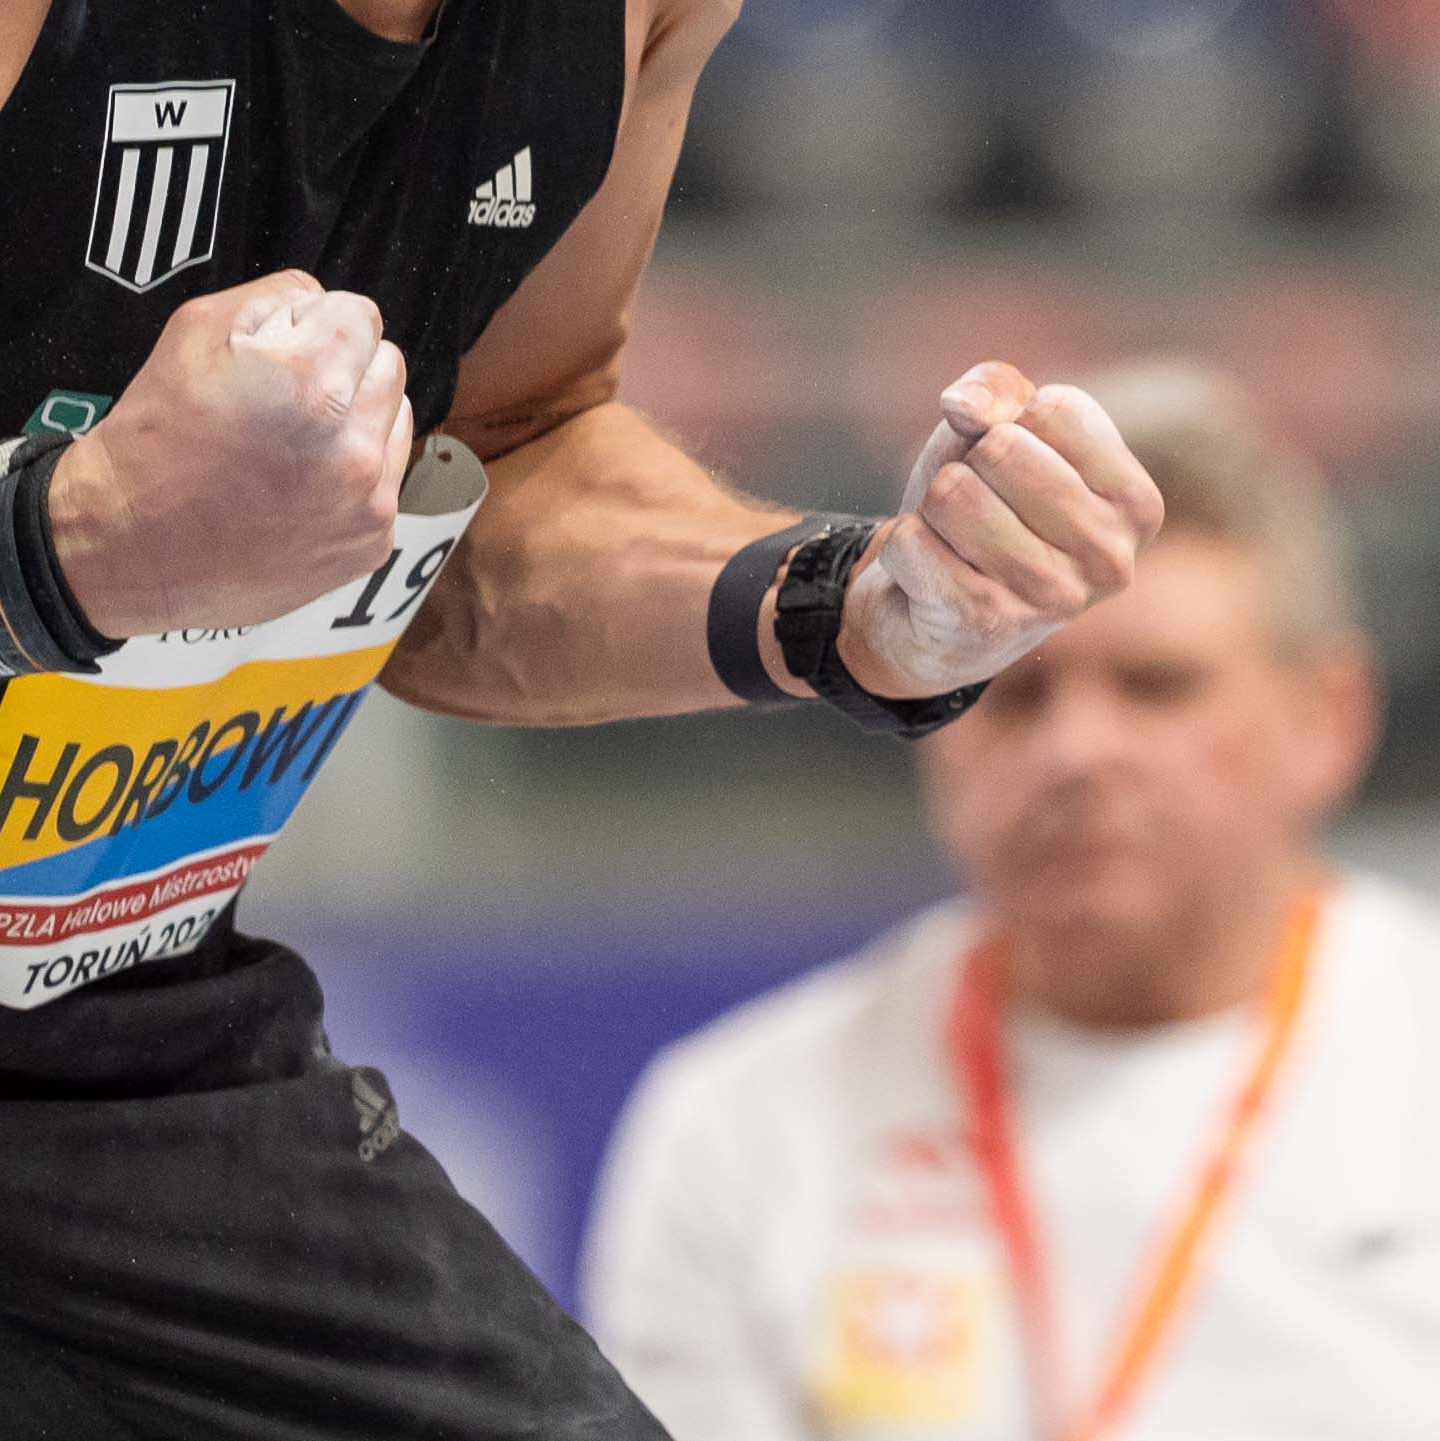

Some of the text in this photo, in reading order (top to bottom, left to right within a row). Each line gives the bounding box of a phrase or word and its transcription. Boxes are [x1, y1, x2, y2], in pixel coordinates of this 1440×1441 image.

[154, 100, 188, 128] W
[60, 892, 147, 935] Halowe
[23, 926, 152, 995] TORUŃ
